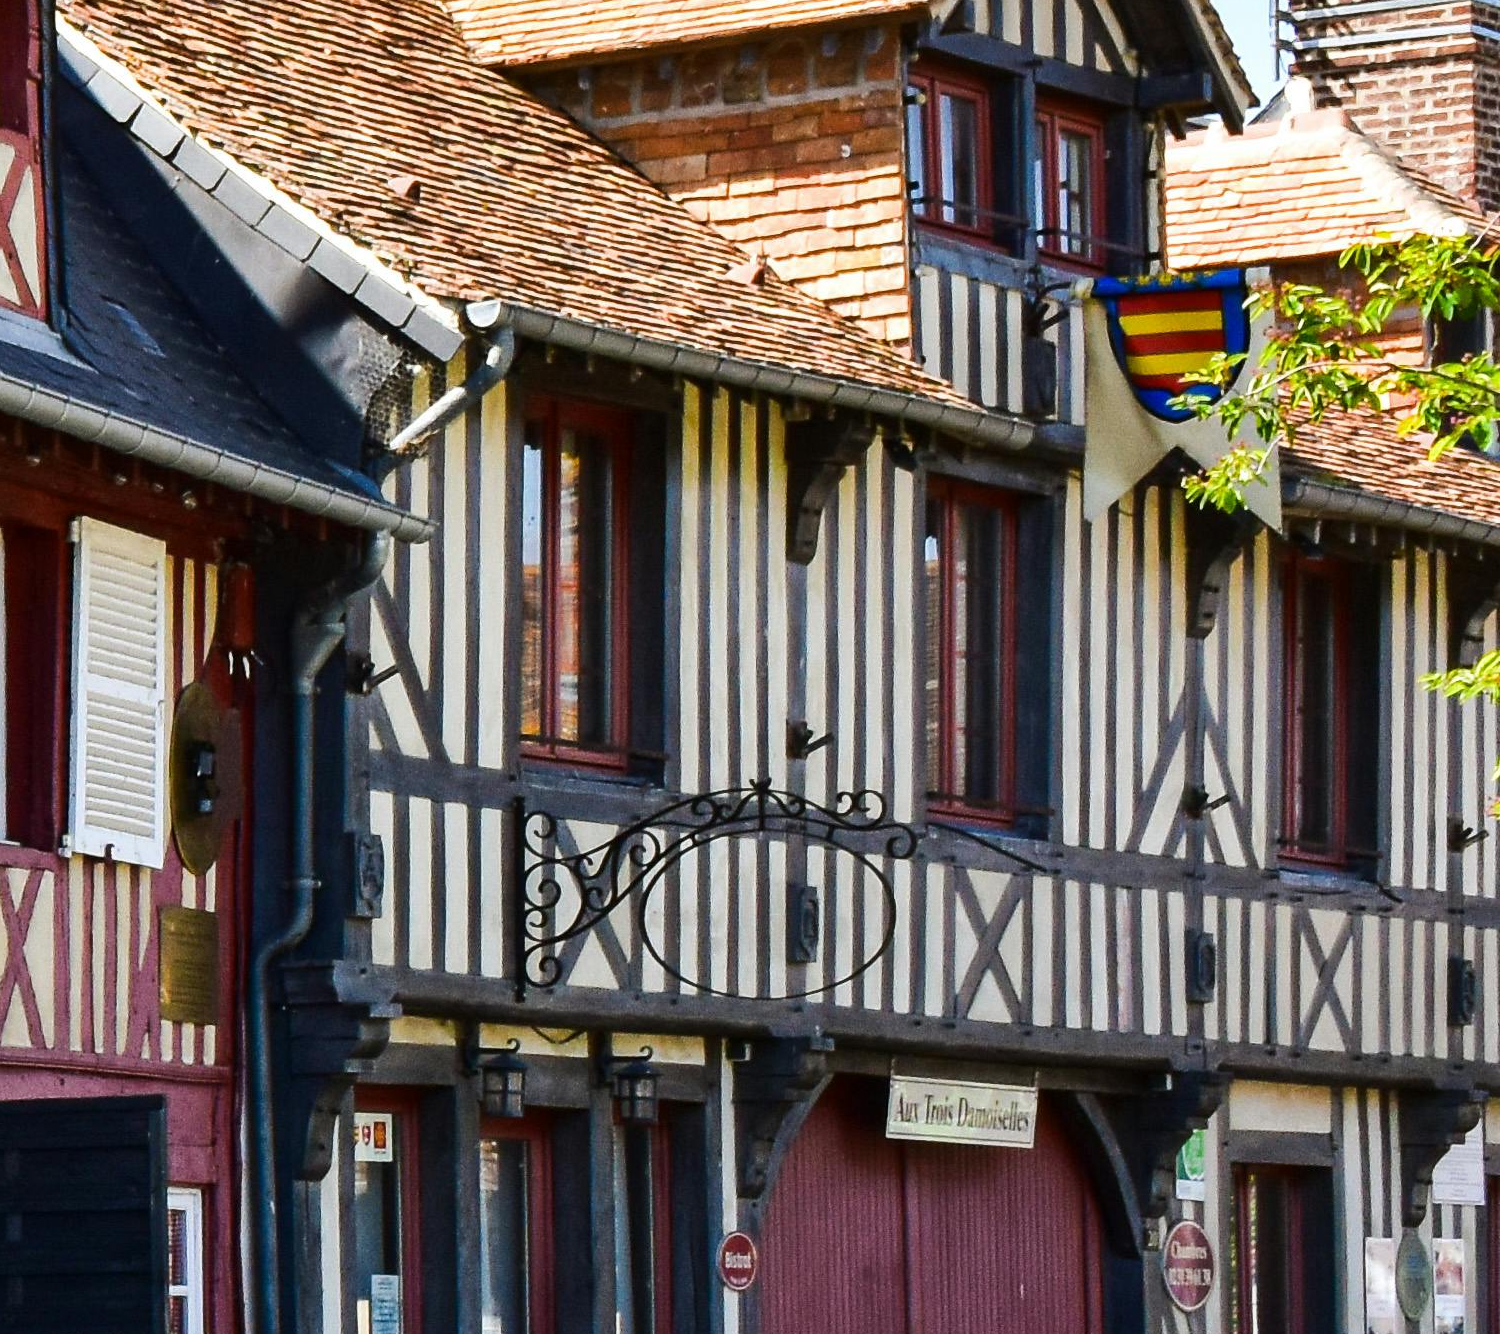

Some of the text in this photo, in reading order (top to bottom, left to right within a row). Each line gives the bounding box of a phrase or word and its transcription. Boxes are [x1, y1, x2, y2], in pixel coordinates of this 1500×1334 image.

[894, 1091, 1030, 1133] Aux Trois Damoiselles
[725, 1252, 752, 1269] Bistrot
